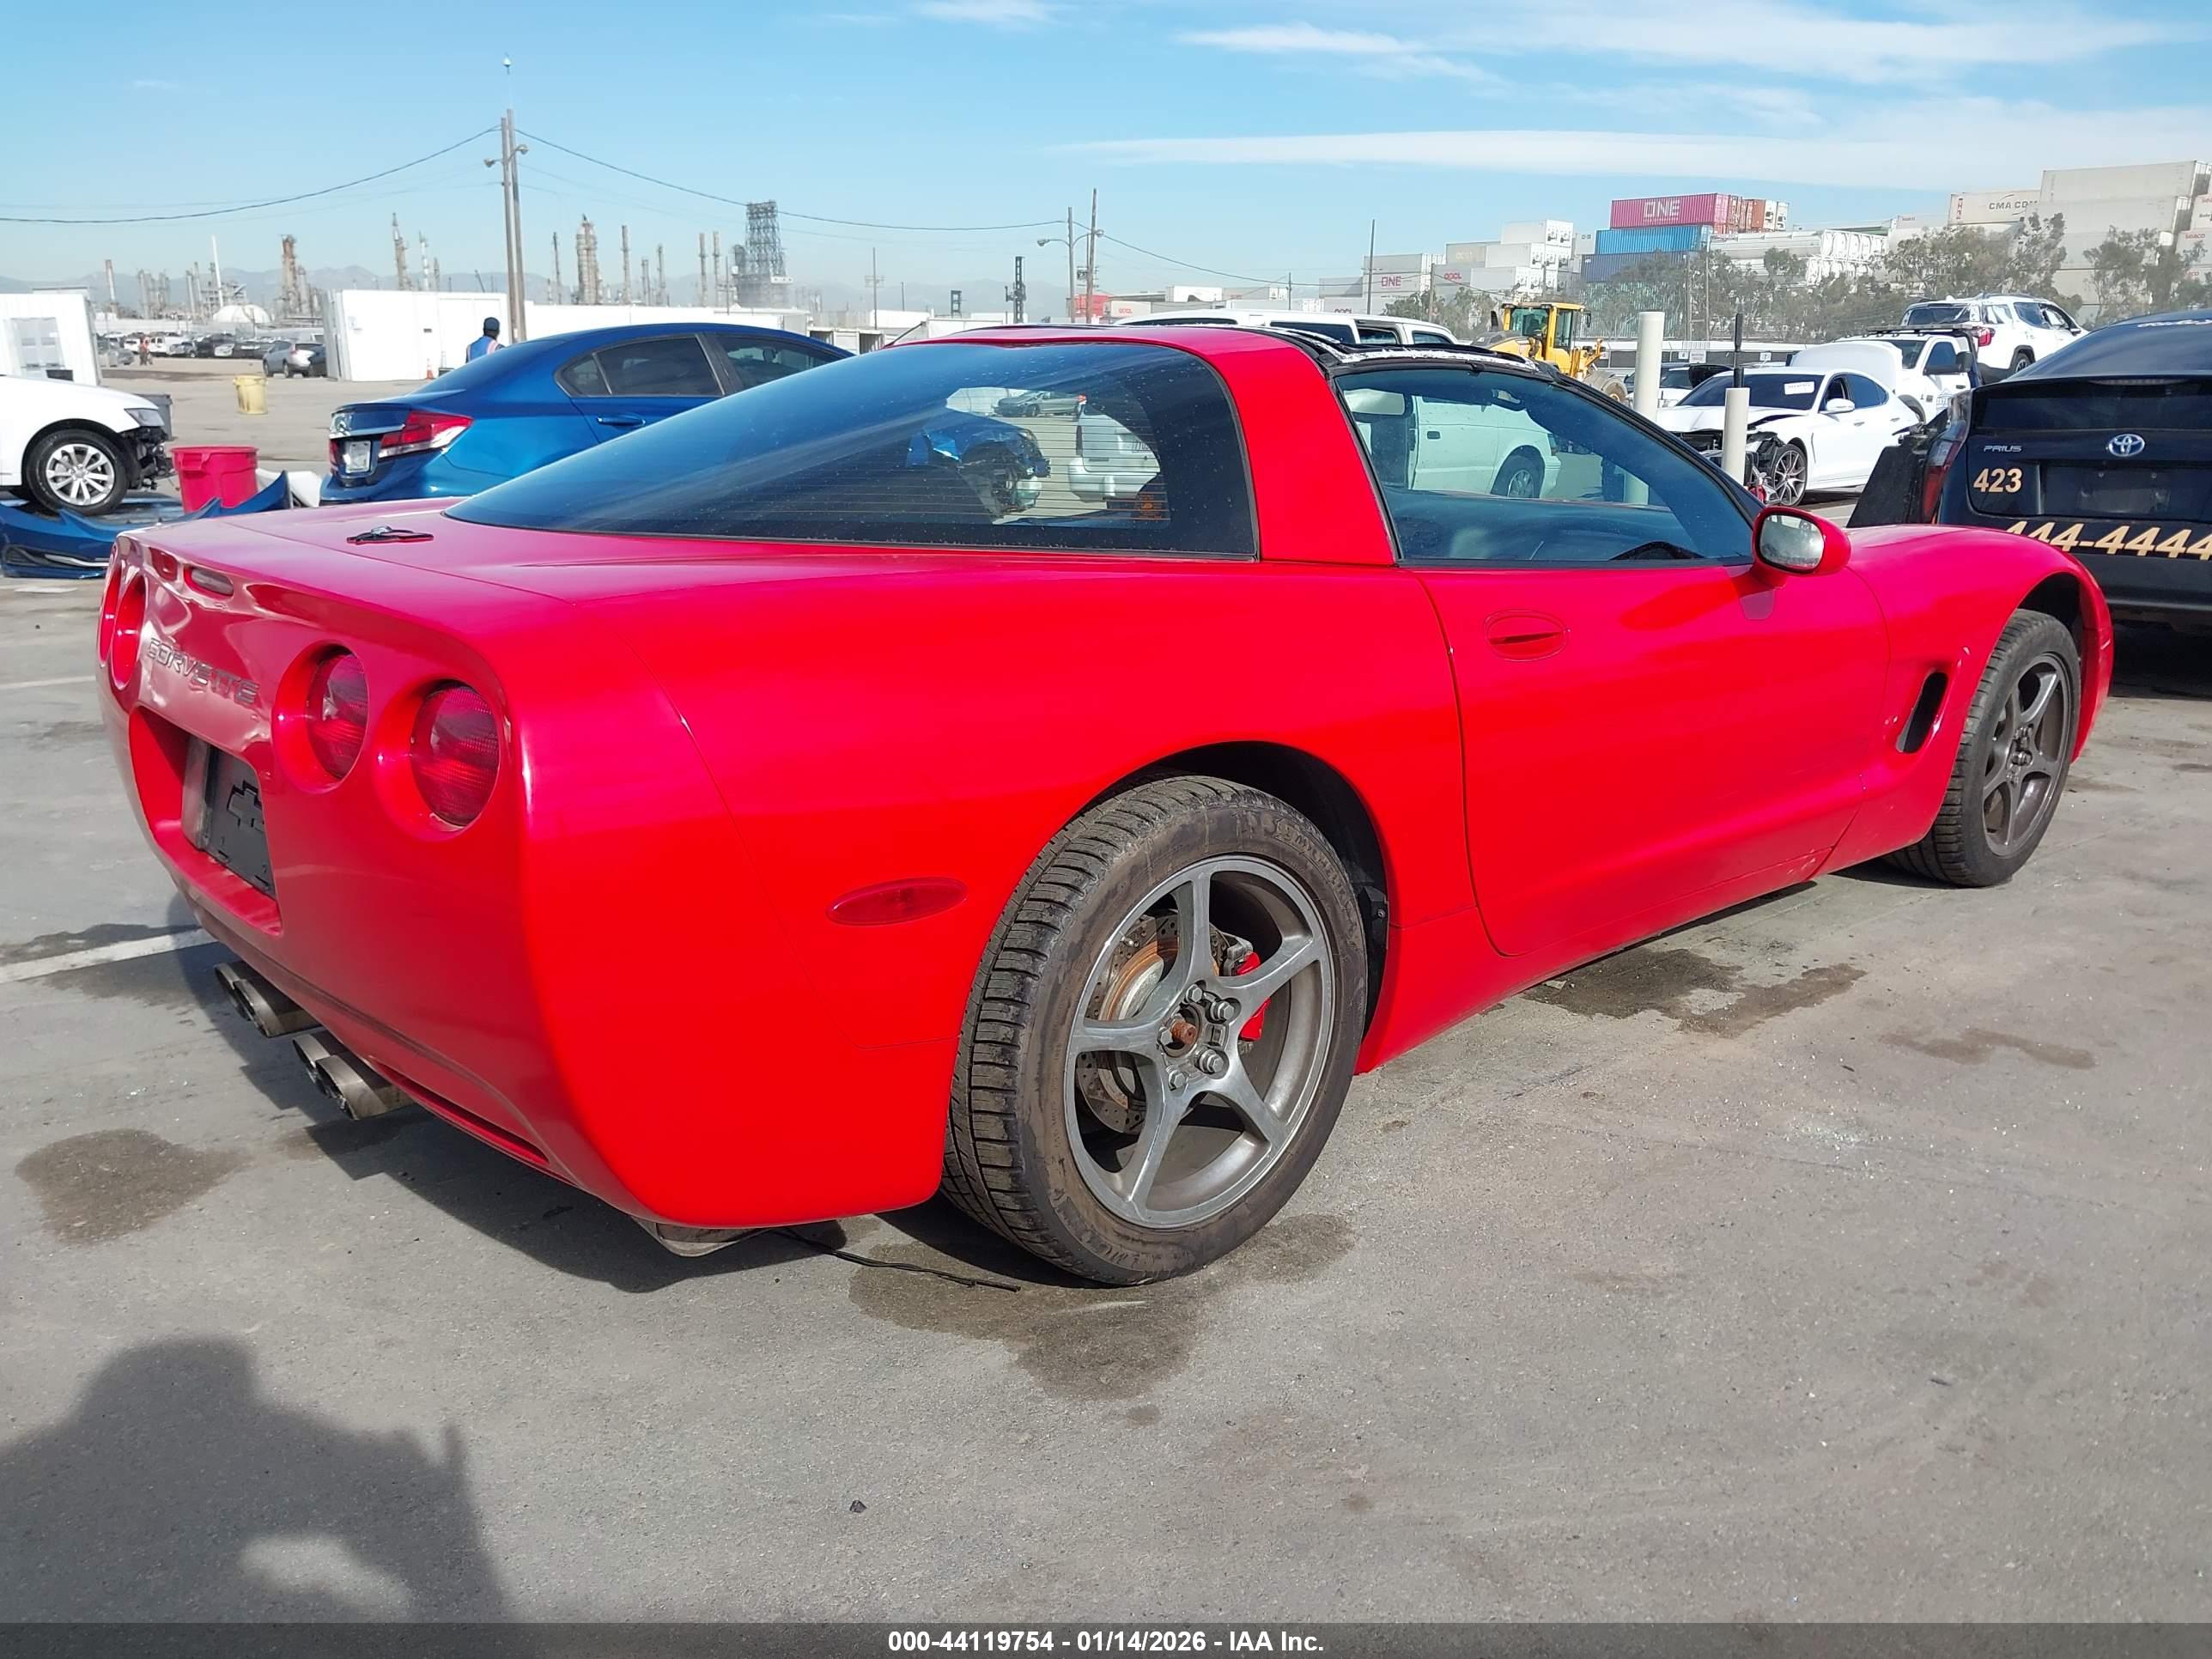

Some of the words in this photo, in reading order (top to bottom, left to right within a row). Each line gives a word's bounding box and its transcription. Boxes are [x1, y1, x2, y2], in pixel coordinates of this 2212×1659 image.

[1644, 199, 1680, 218] ONE
[1381, 276, 1401, 287] ONE
[1973, 468, 2022, 493] 423
[148, 637, 260, 704] CORVETTE
